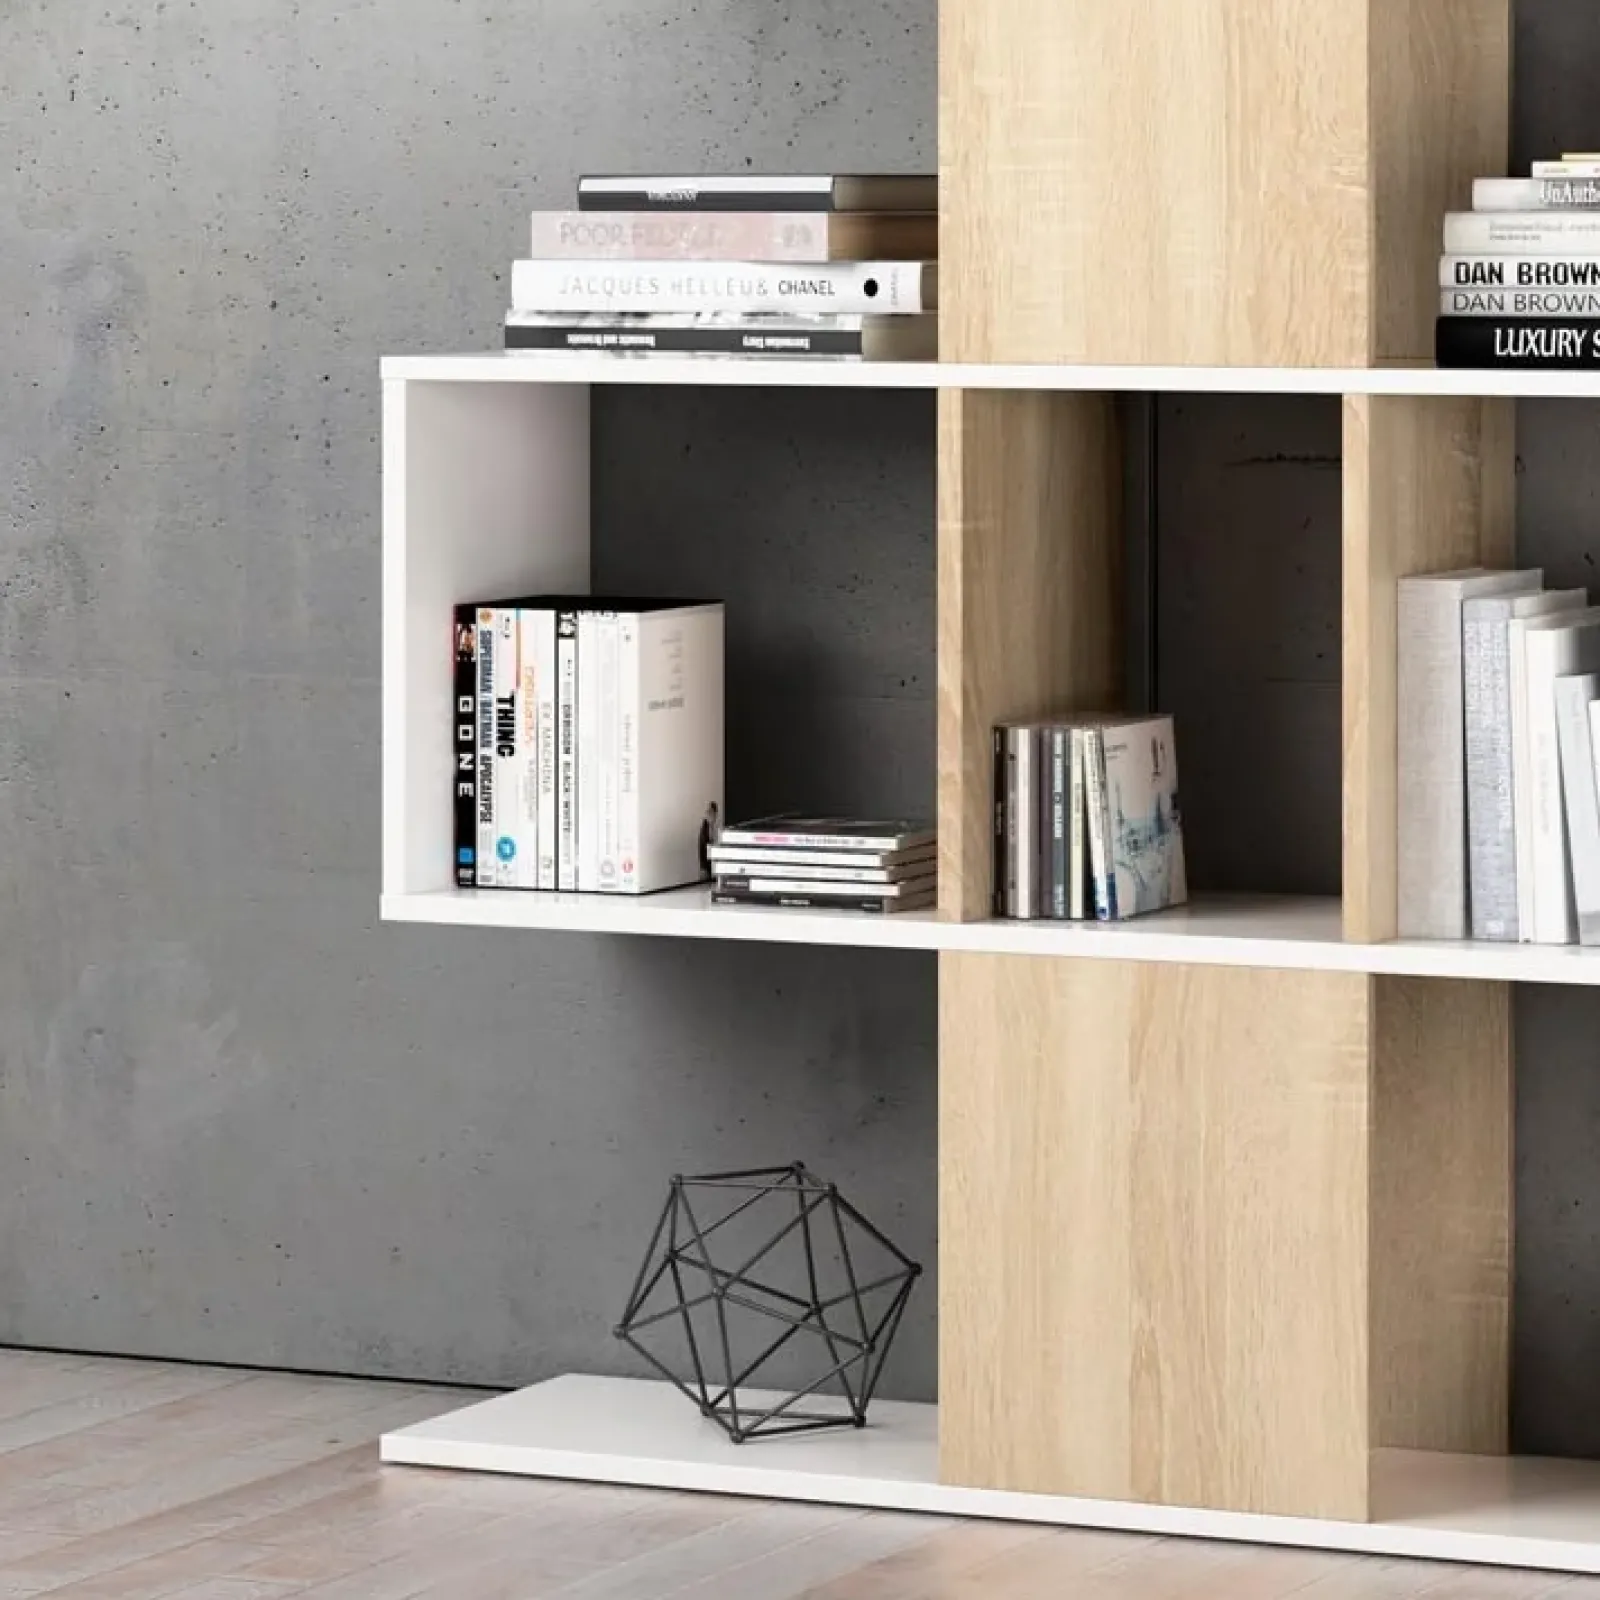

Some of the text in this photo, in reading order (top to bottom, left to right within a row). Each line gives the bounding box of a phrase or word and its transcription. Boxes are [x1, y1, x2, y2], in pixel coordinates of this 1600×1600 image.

[559, 275, 660, 296] JACQUES
[778, 279, 835, 295] CHANEL
[1454, 261, 1504, 285] DAN
[1453, 293, 1600, 313] DAN BROWN
[1494, 327, 1587, 358] LUXURY
[496, 692, 515, 758] THING
[458, 695, 474, 797] GONE
[541, 727, 552, 794] MACHINA
